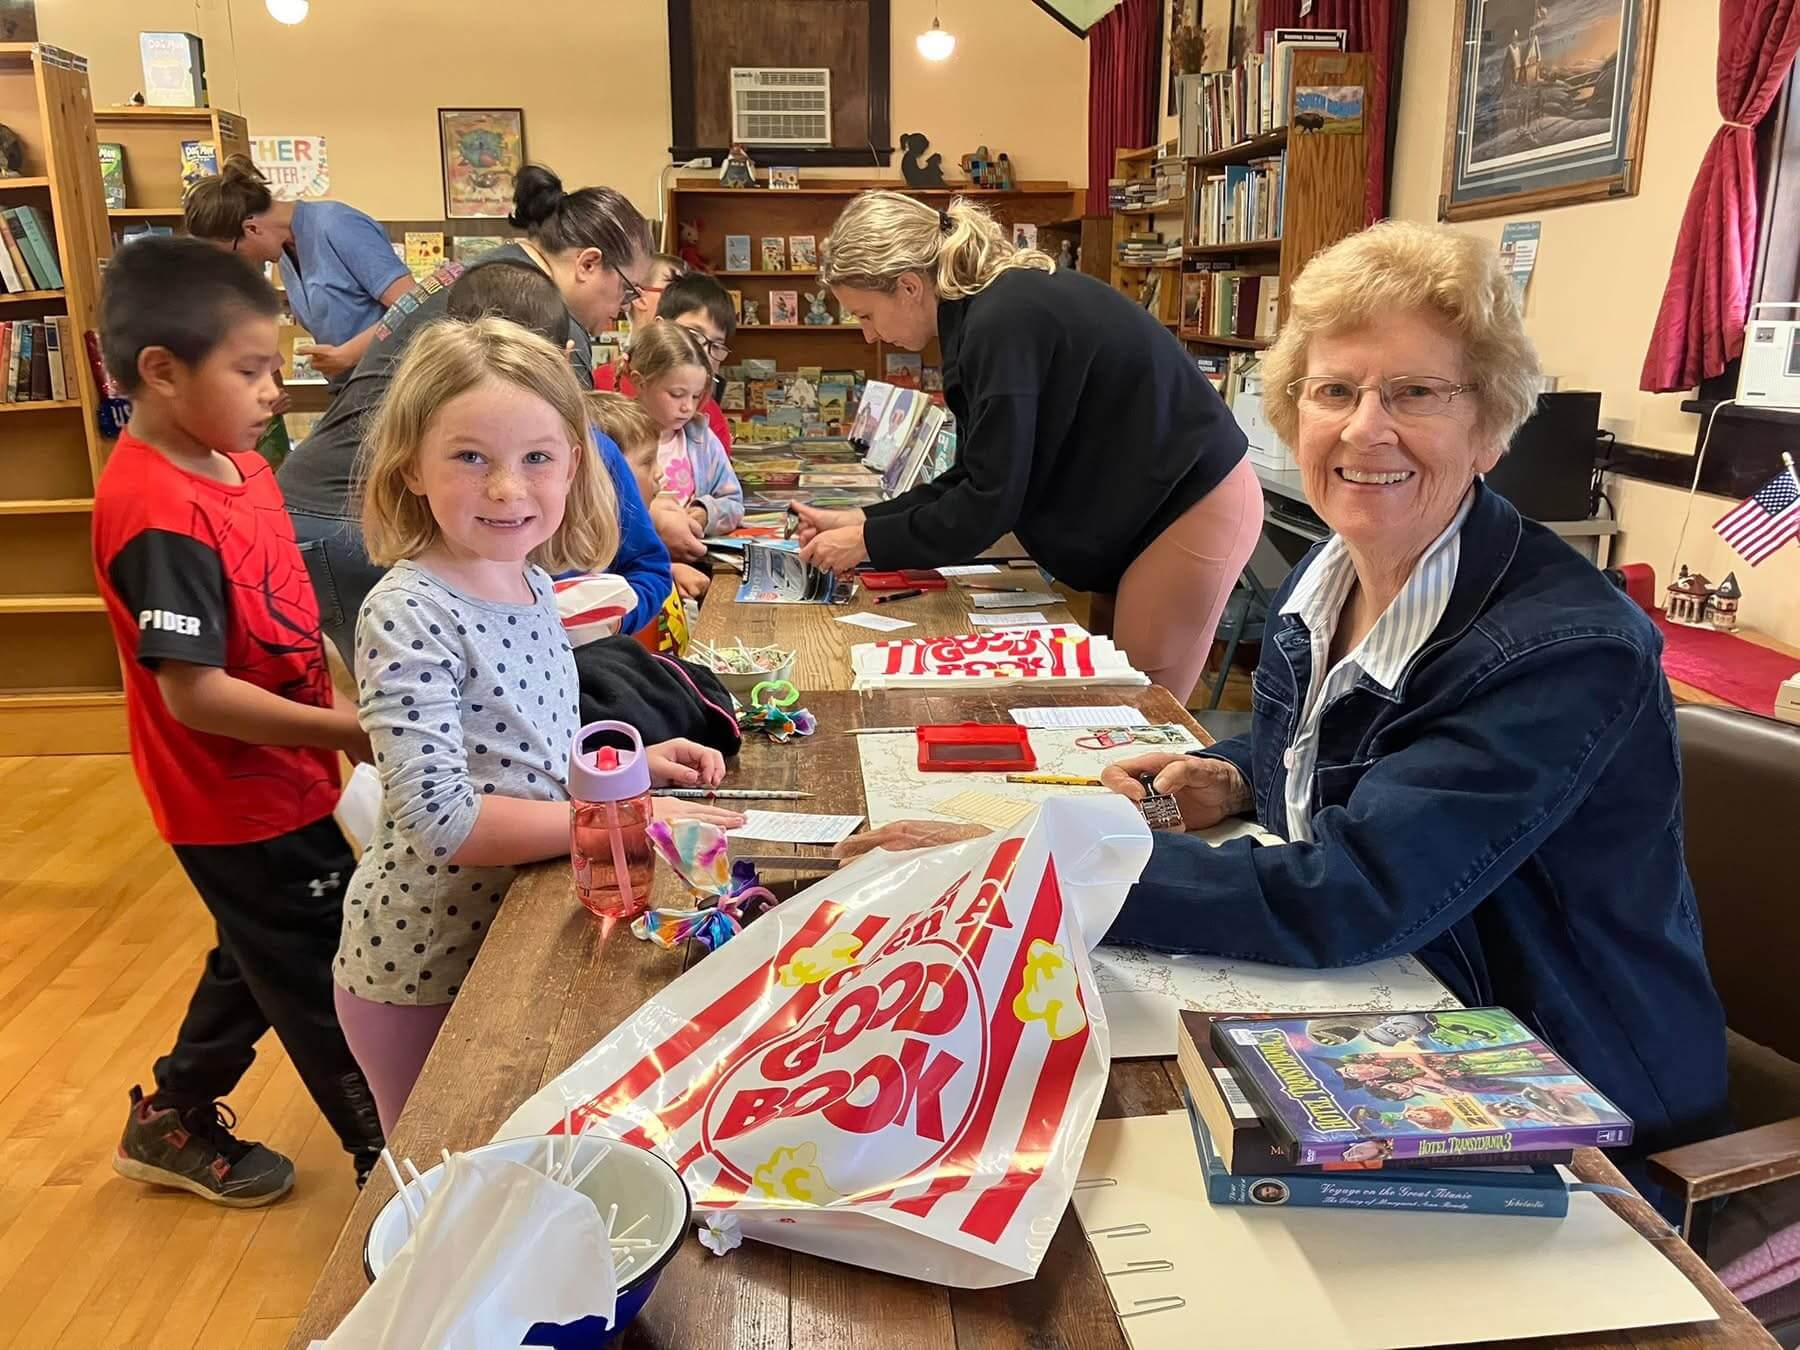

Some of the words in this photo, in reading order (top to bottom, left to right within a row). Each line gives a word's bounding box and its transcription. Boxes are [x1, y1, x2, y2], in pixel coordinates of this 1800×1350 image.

[258, 166, 300, 185] TTER
[138, 608, 201, 637] PIDER
[759, 960, 969, 1081] GOOD
[712, 1038, 964, 1142] BOOK
[1418, 1138, 1448, 1156] HOTEL
[1448, 1133, 1504, 1154] TRANSYLVANIA
[1320, 1183, 1361, 1196] Voyage
[1378, 1186, 1396, 1196] the
[1398, 1184, 1431, 1198] Great
[1431, 1187, 1473, 1200] Titanic
[1503, 1198, 1545, 1209] Scholastic
